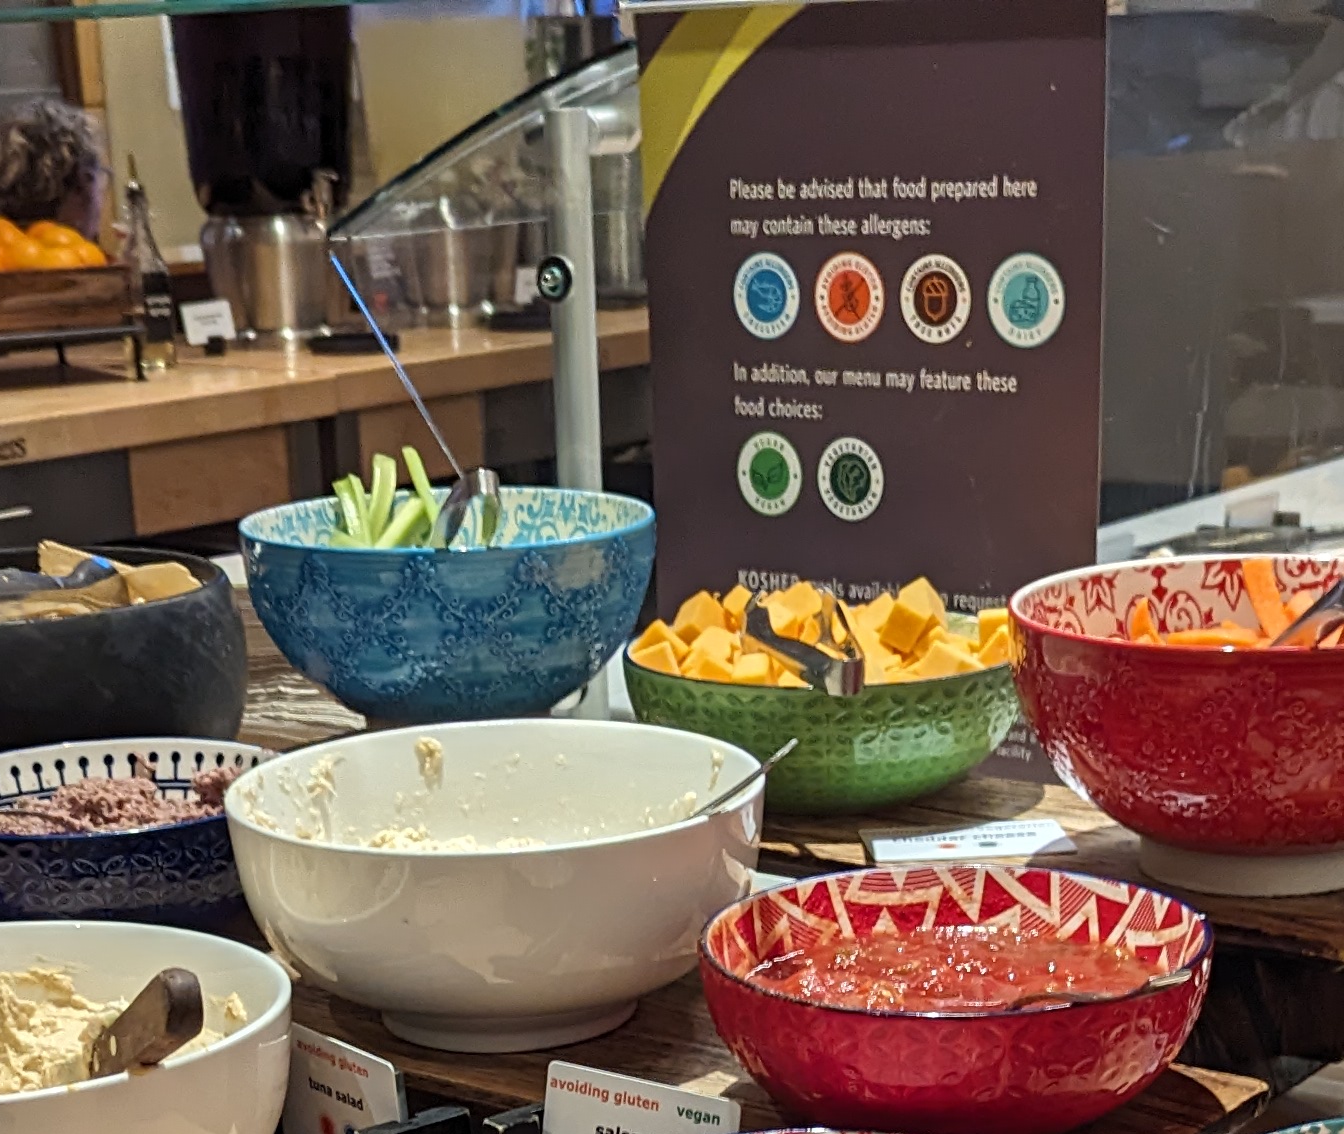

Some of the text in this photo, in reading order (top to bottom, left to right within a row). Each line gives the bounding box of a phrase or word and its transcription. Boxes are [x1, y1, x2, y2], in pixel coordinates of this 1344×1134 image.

[729, 175, 1038, 202] Please be advised that food prepared here
[730, 213, 931, 241] may contain these allergens:
[733, 362, 1018, 393] In addition, our menu may feature these
[734, 395, 823, 419] food choices:
[297, 1039, 369, 1078] avoiding gluten
[308, 1076, 364, 1111] tuna salad
[550, 1077, 721, 1126] avoiding gluten vegan
